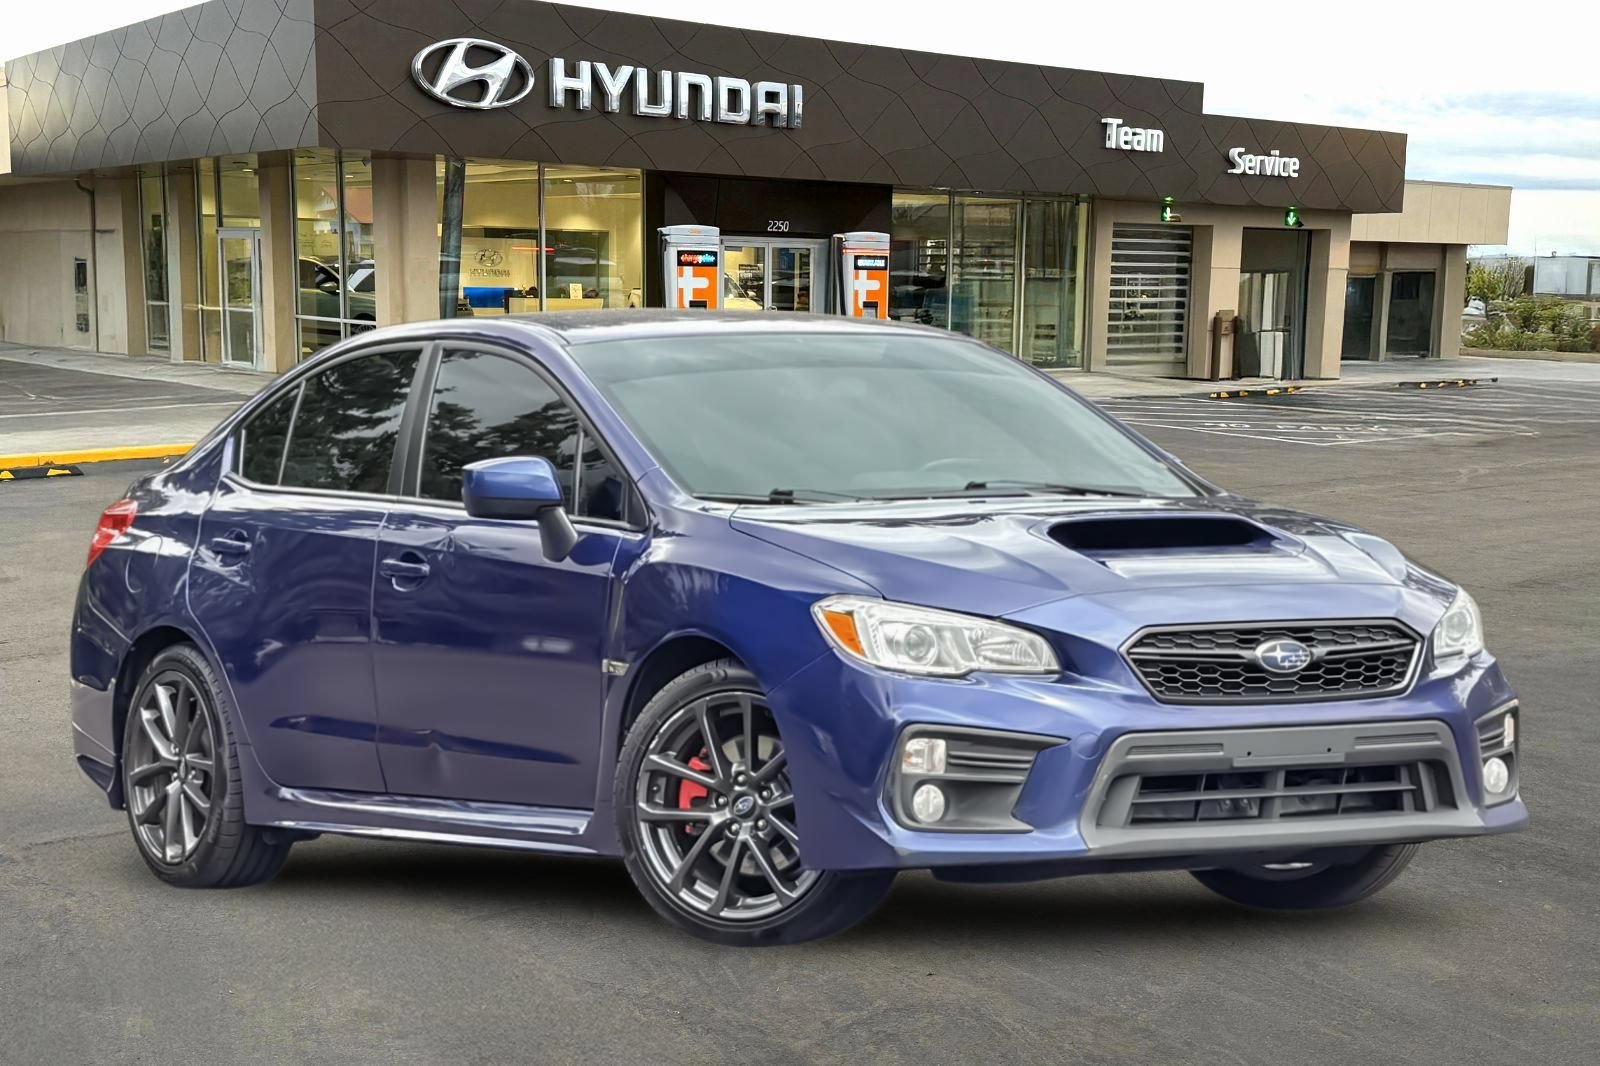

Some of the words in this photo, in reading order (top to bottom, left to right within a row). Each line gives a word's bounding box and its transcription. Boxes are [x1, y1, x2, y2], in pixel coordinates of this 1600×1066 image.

[549, 57, 803, 129] HYUNDAI
[1101, 118, 1164, 153] Team
[1227, 147, 1300, 178] Service
[767, 220, 789, 232] 2250
